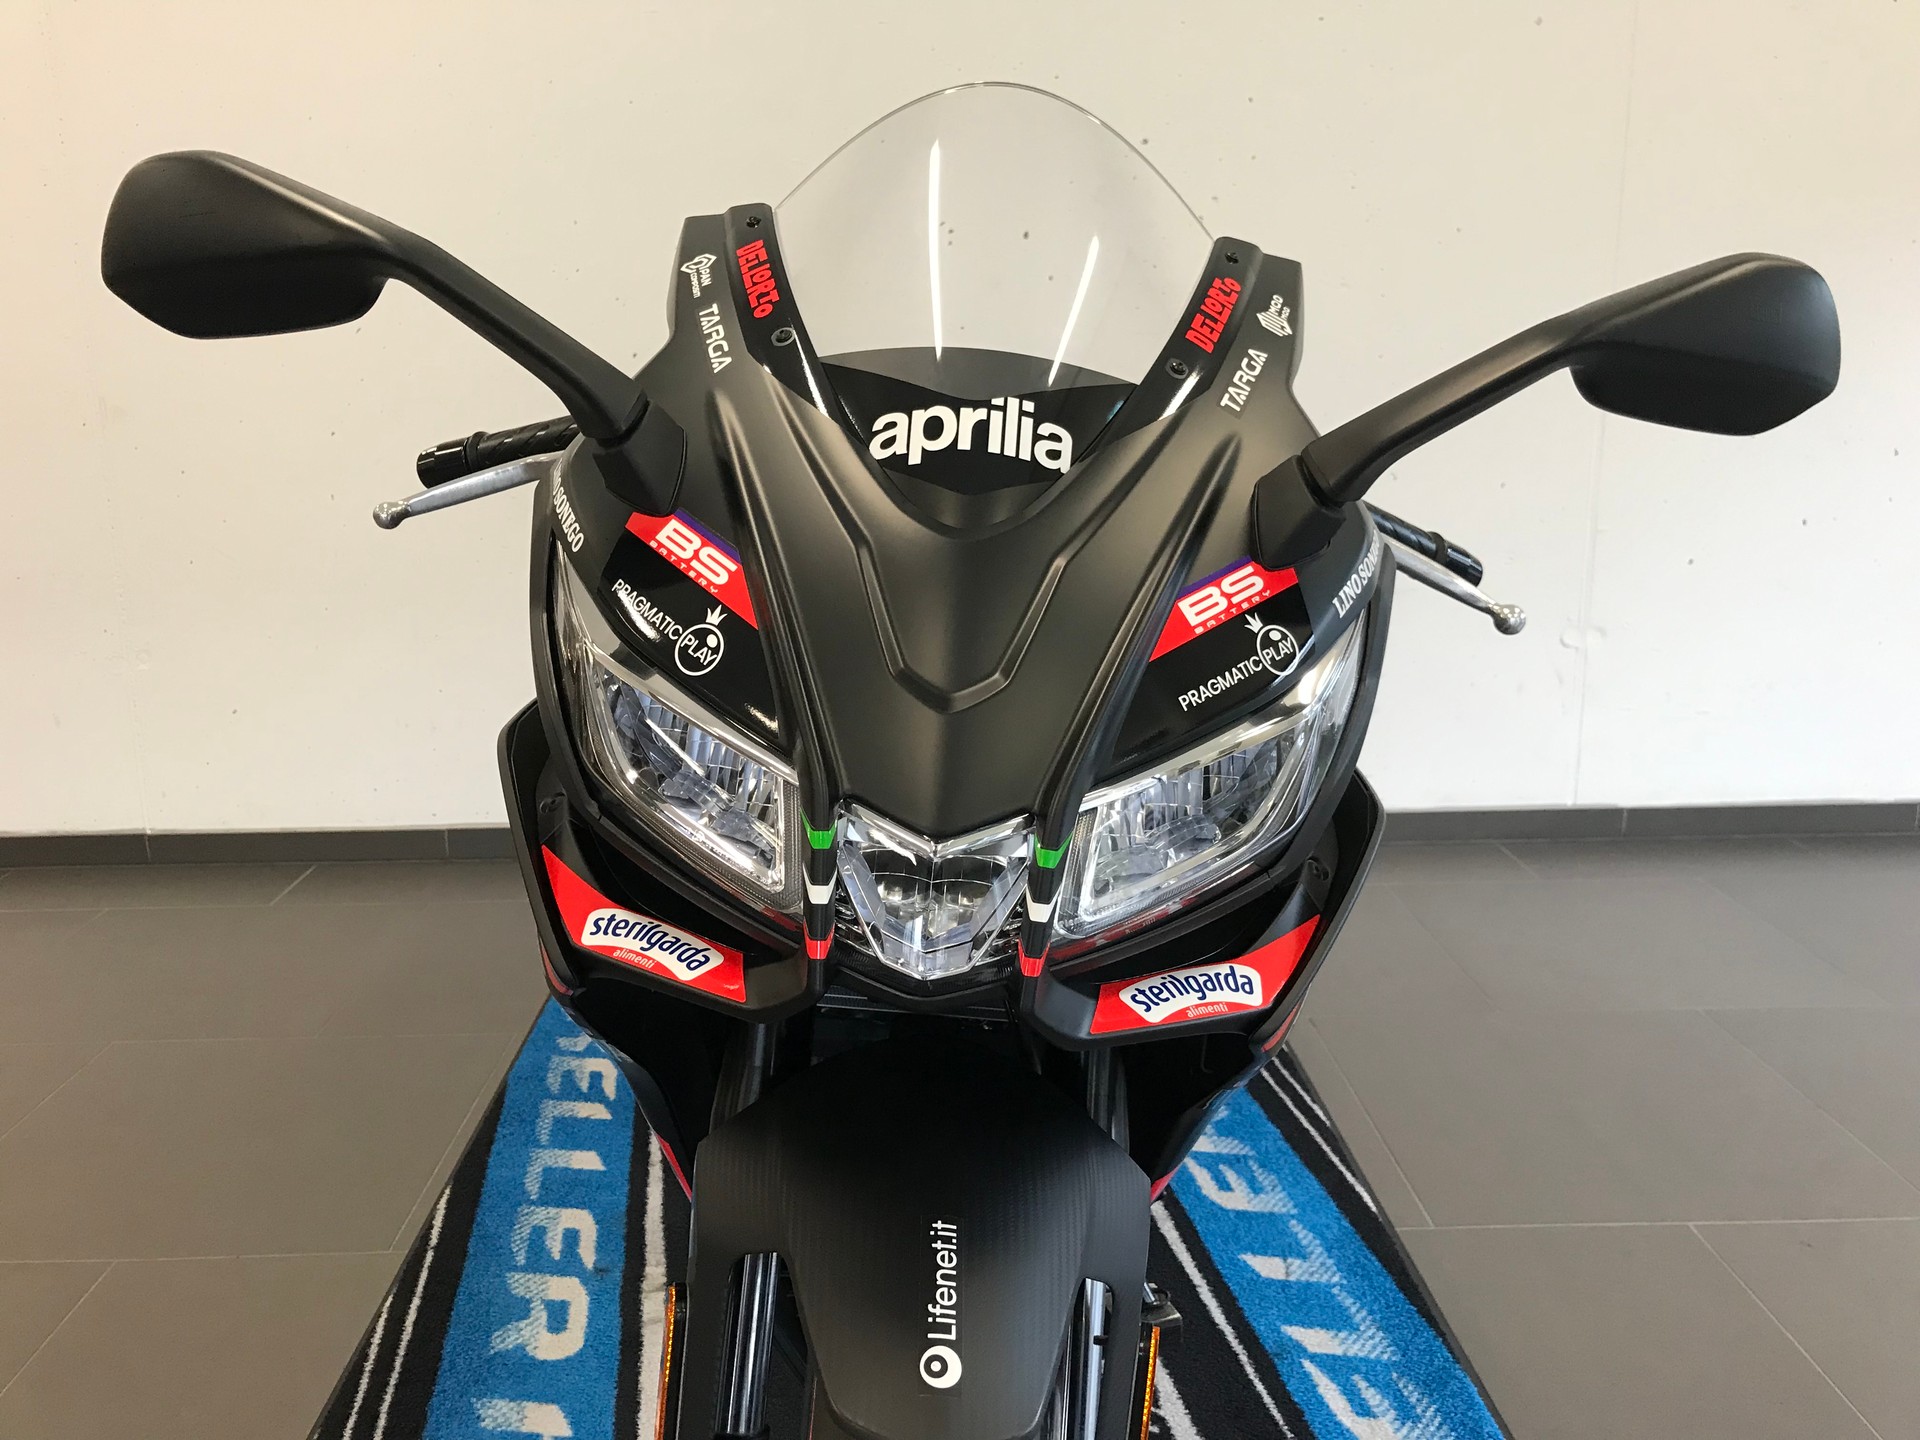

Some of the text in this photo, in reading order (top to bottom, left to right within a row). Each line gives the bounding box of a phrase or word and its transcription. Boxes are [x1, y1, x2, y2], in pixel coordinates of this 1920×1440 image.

[698, 266, 713, 287] PAN
[698, 302, 733, 374] TARGA
[1219, 348, 1269, 412] TARGA
[869, 396, 1073, 475] aprilia
[553, 486, 585, 553] SONEGO
[649, 540, 719, 594] BATTERY
[655, 518, 738, 586] BS
[1332, 529, 1380, 619] LINO SON
[611, 578, 718, 666] PRAGMATIC PLAY
[1177, 565, 1265, 627] BS
[1193, 589, 1272, 635] BATTERY
[1178, 637, 1295, 712] PRAGMATIC PLAY
[589, 913, 713, 972] sterilgarda
[612, 948, 657, 969] alimenti
[1130, 965, 1255, 1013] sterilgarda
[1185, 1002, 1229, 1019] alimenti
[927, 1220, 958, 1341] Lifenet.it
